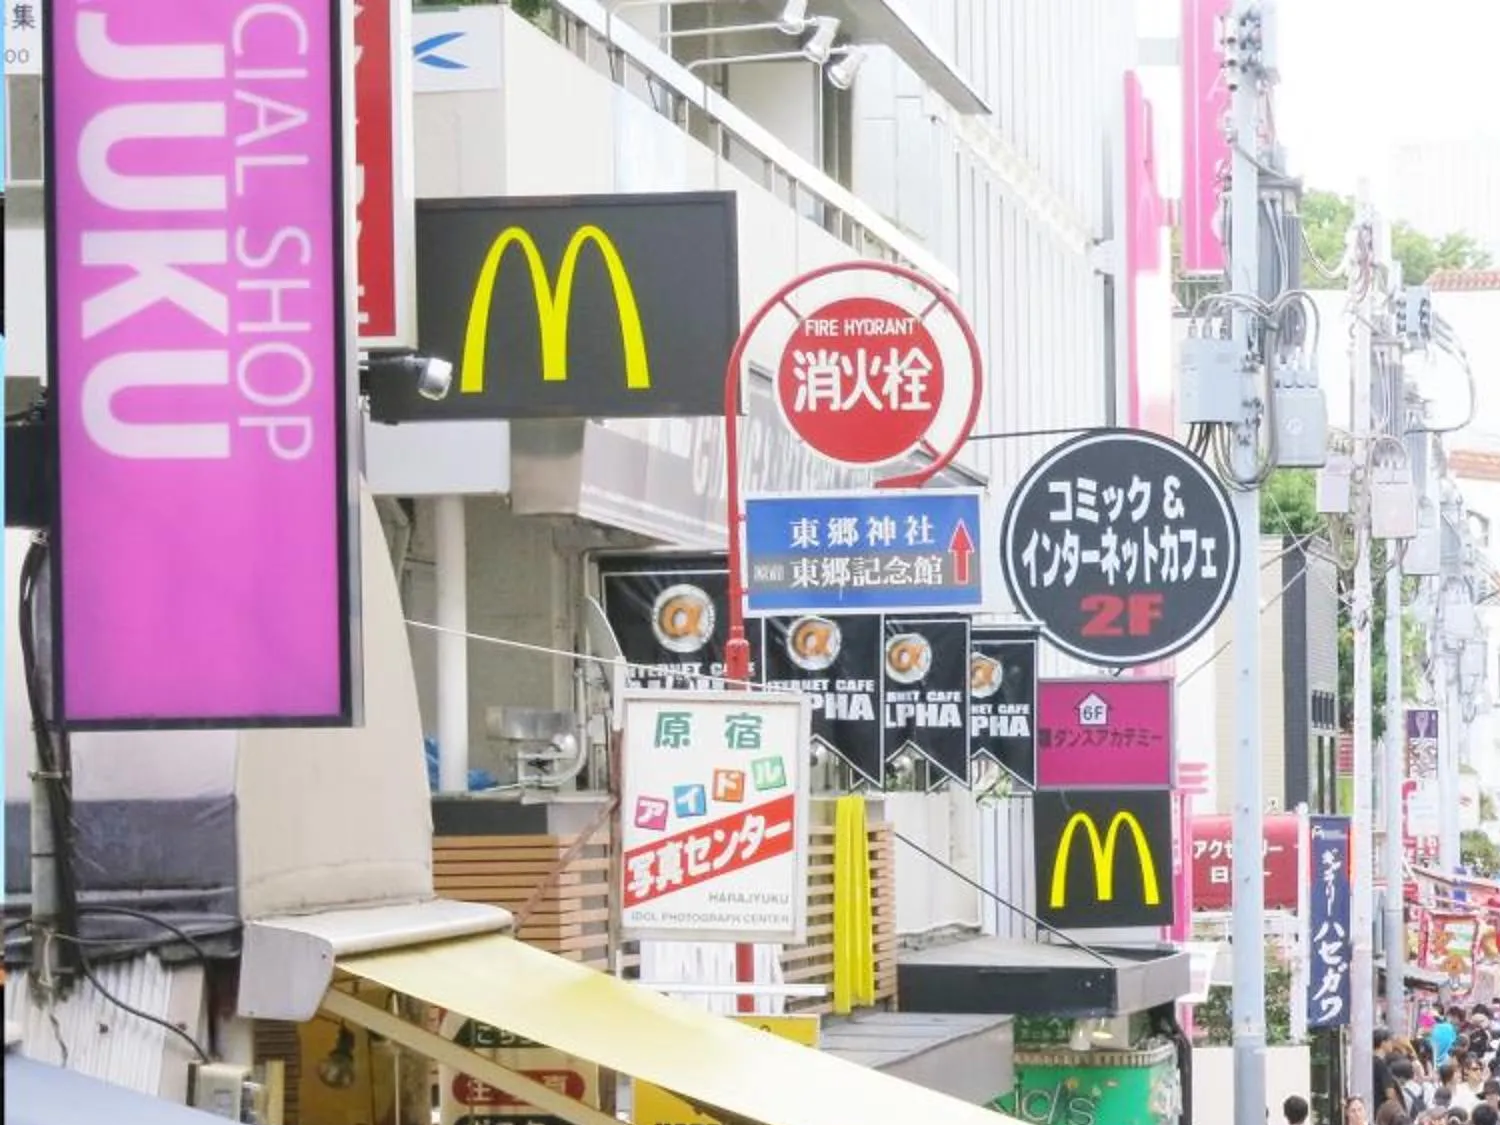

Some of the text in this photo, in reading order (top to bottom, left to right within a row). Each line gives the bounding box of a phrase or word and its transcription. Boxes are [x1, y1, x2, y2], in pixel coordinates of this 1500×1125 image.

[75, 0, 230, 460] JUKU
[235, 226, 313, 461] SHOP
[805, 317, 918, 337] FIRE HYDRANT
[792, 347, 933, 413] 消火栓
[1047, 475, 1185, 524] コミック &
[789, 514, 936, 549] 東郷神社
[790, 554, 943, 589] 東郷記念館
[1021, 525, 1217, 589] インターネットカフェ
[1079, 593, 1166, 638] 2F
[835, 678, 875, 693] CAFE
[926, 690, 962, 704] CAFE
[653, 711, 763, 749] 原宿
[997, 704, 1031, 715] CAFE
[1082, 705, 1104, 721] 6F
[635, 757, 785, 829] アイドル
[628, 813, 792, 898] 写真センター
